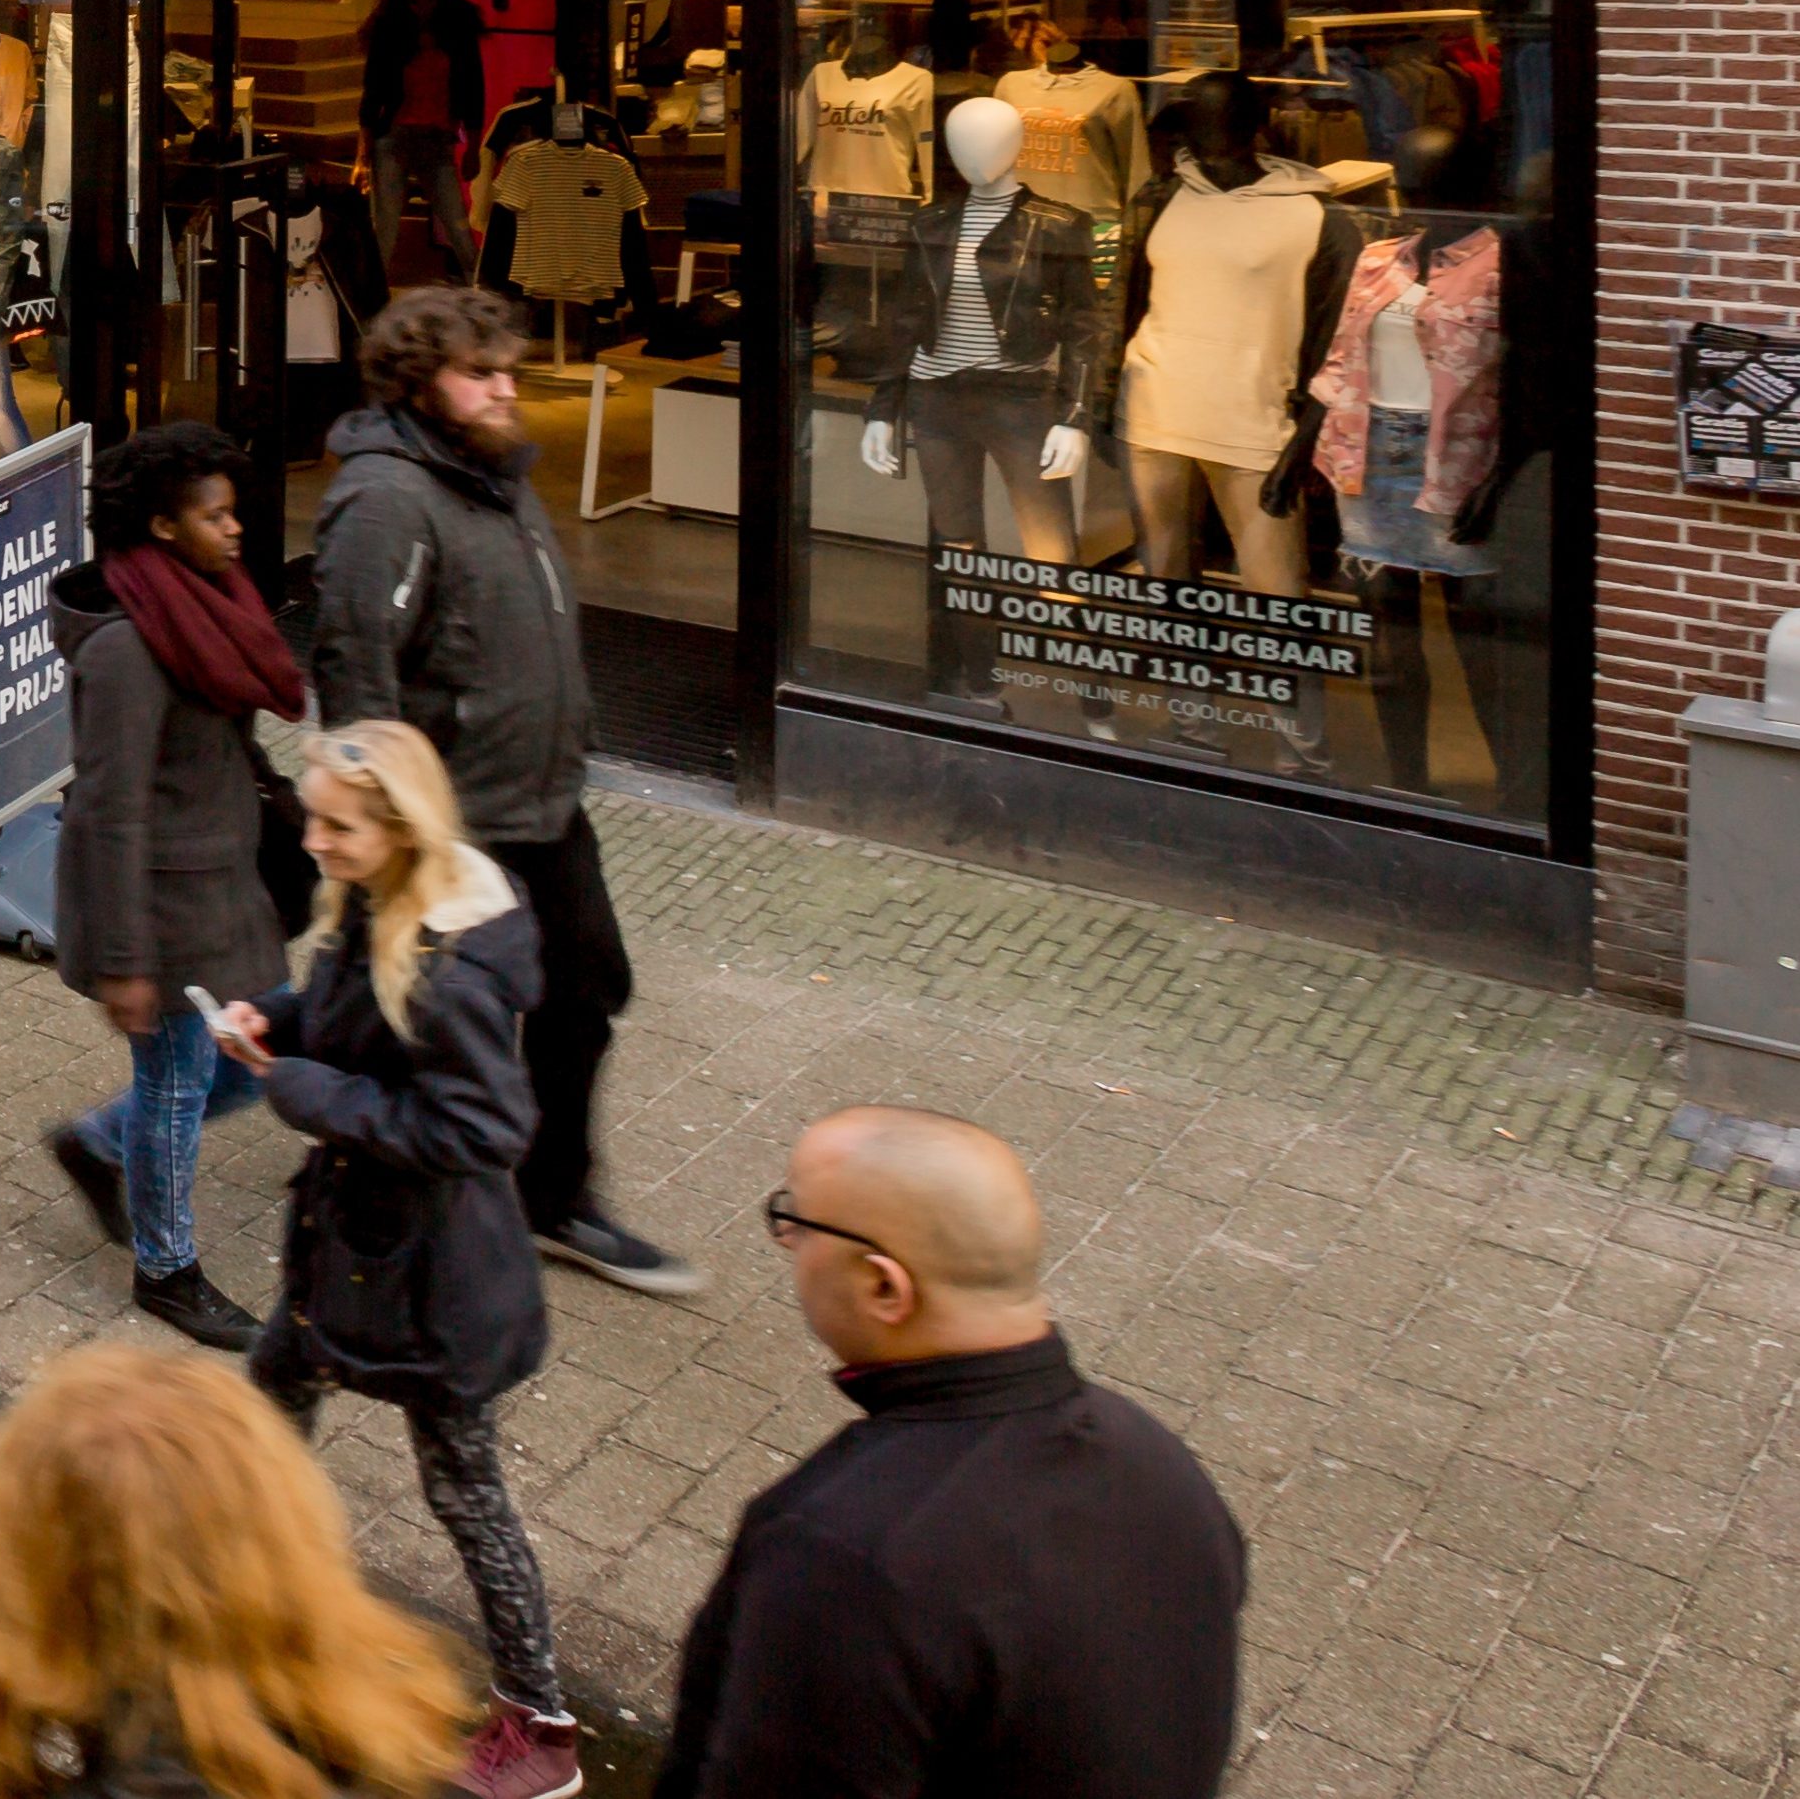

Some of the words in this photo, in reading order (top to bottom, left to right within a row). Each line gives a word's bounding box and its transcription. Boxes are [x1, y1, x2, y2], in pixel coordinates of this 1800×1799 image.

[817, 99, 885, 127] Catch
[1016, 154, 1076, 174] PIZZA
[1, 520, 57, 581] ALLE
[934, 550, 1059, 590] JUNIOR
[1067, 570, 1168, 605] GIRLS
[1175, 586, 1373, 637] COLLECTIE
[10, 618, 54, 672] HAL
[946, 587, 993, 614] NU
[1001, 596, 1074, 628] OOK
[1080, 608, 1355, 674] VERKRIJGBAAR
[0, 657, 65, 725] PRIJS
[1001, 632, 1036, 658] IN
[1045, 639, 1140, 675] MAAT
[1147, 657, 1292, 701] 110-116
[990, 667, 1048, 689] SHOP
[1053, 678, 1132, 706] ONLINE
[1136, 693, 1163, 711] AT
[1167, 698, 1305, 737] COOLCAT.NL
